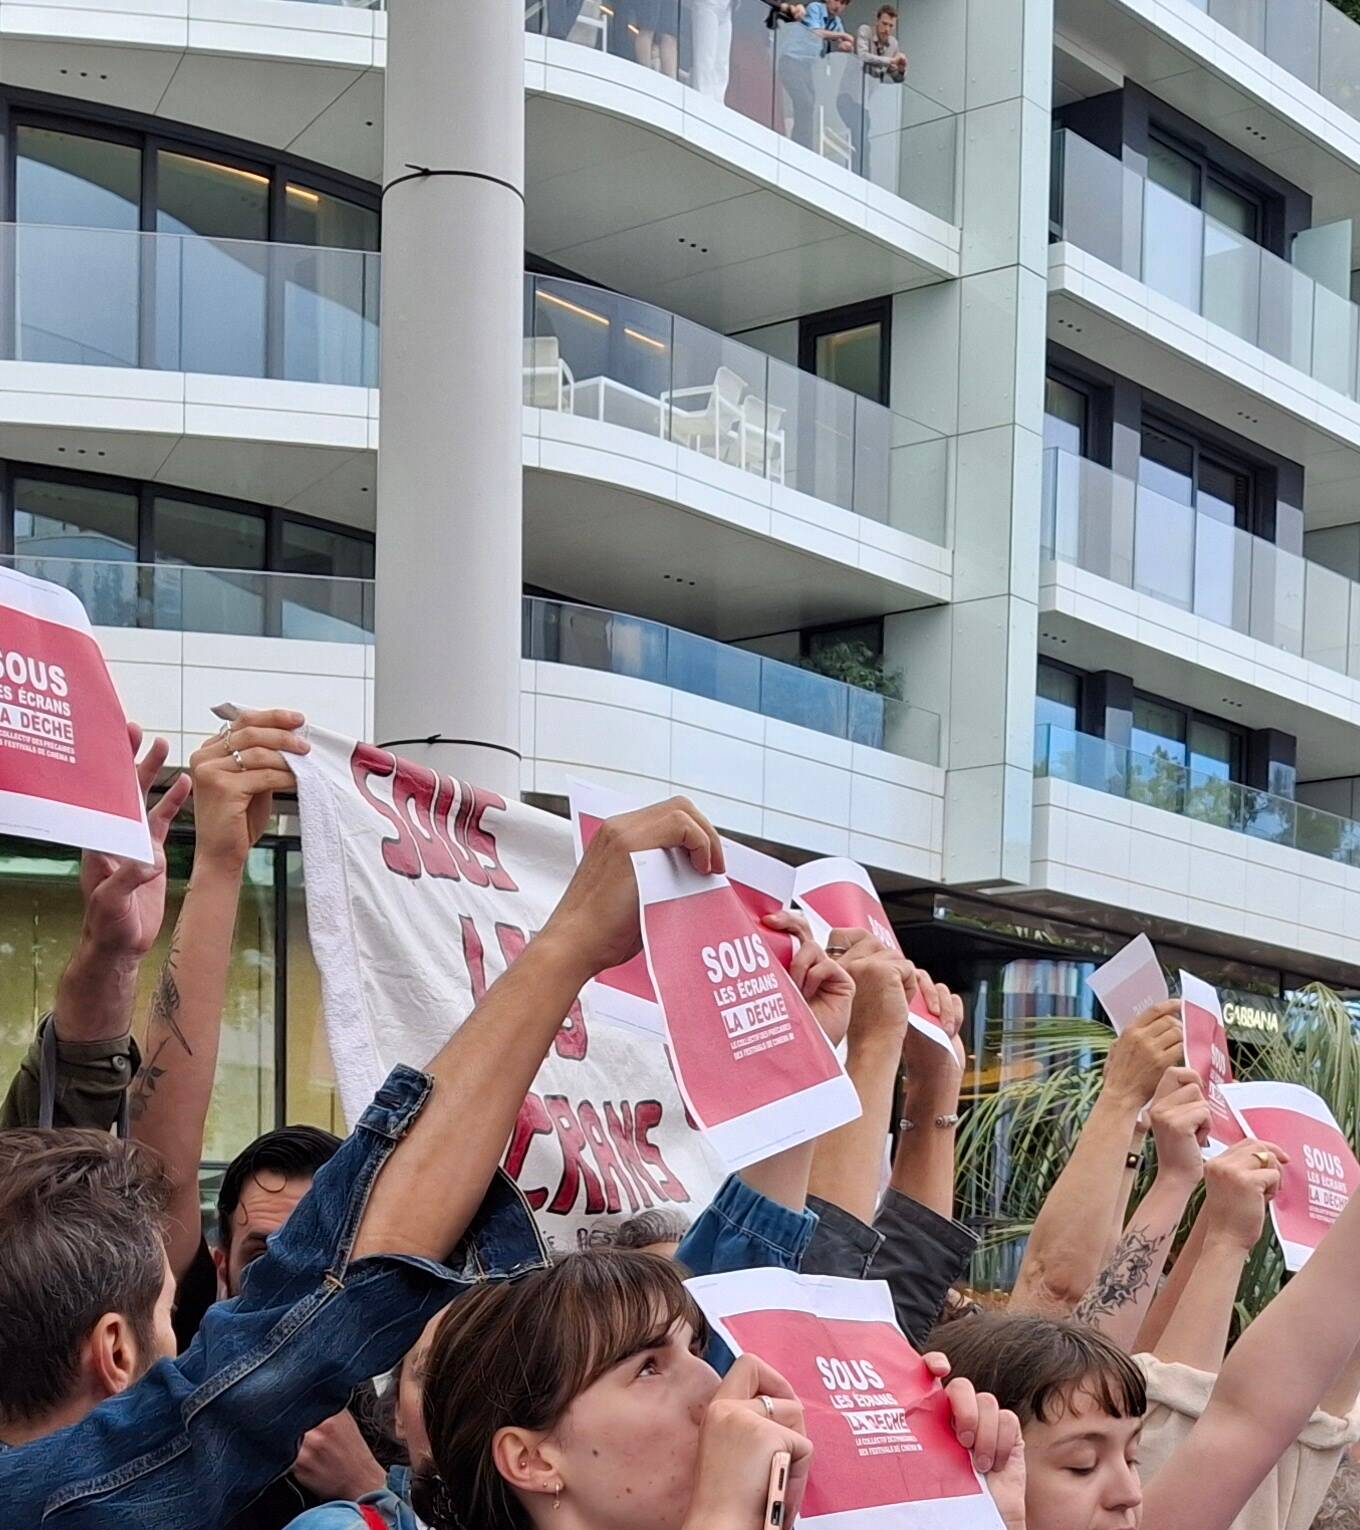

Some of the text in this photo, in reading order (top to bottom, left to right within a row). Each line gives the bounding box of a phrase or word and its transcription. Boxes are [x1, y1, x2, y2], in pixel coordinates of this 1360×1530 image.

[18, 687, 71, 716] ÉCRANS
[351, 741, 519, 892] SOUS
[702, 933, 770, 983] SOUS
[713, 973, 778, 1007] LES ÉCRANS
[723, 1012, 743, 1034] LA
[1223, 1002, 1278, 1033] GABBANA
[1303, 1144, 1344, 1180] SOUS
[816, 1356, 885, 1391] SOUS
[830, 1394, 854, 1409] LES
[847, 1415, 868, 1431] LA
